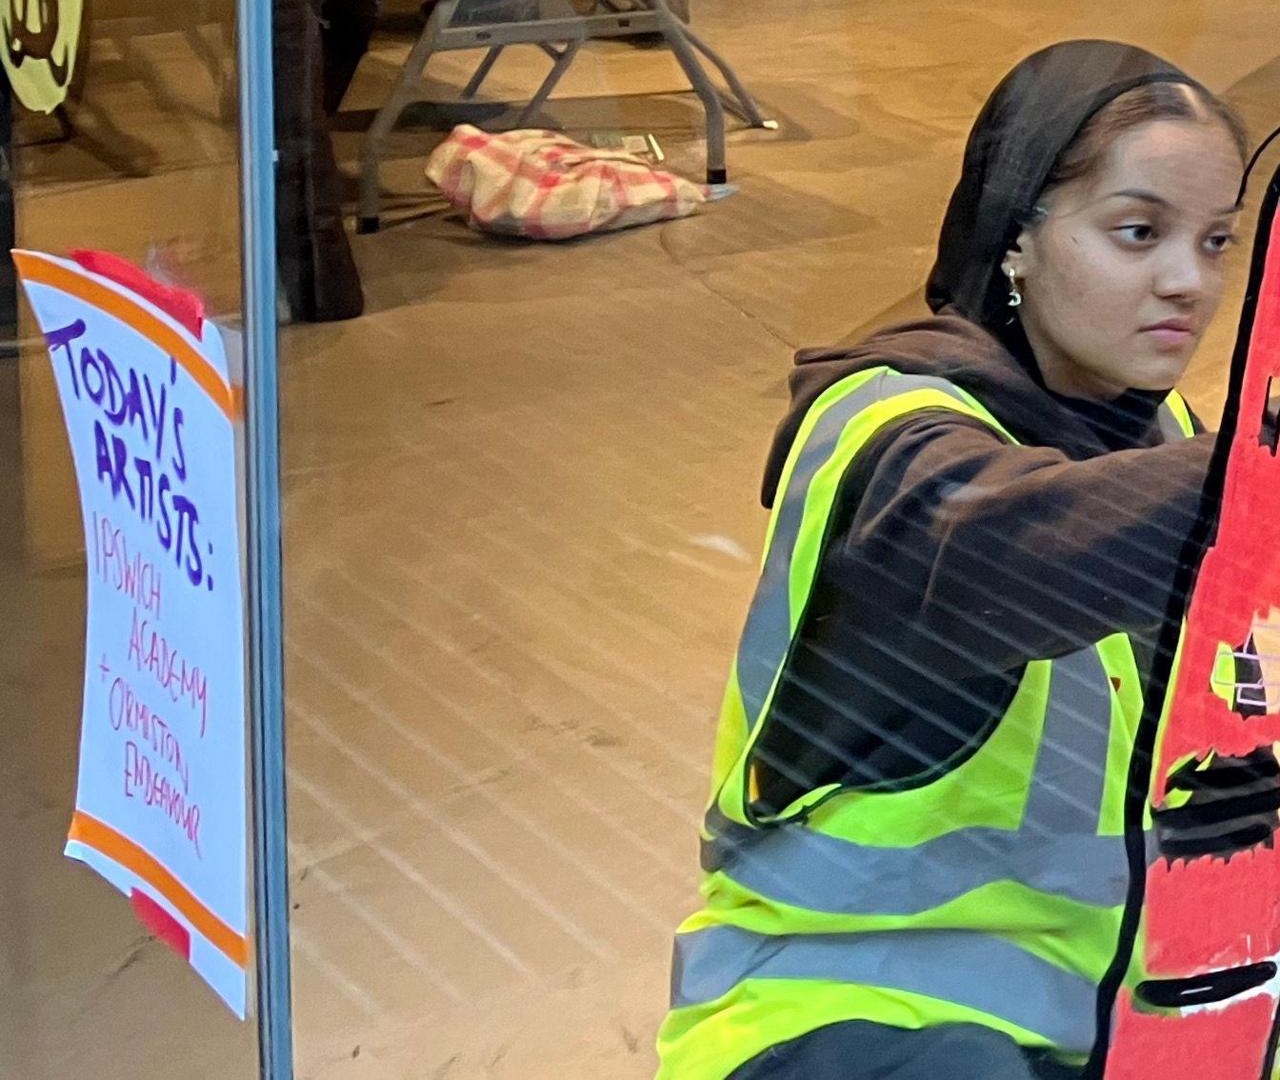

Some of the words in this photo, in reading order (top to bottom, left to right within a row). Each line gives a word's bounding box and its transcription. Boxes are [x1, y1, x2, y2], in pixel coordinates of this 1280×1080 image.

[44, 318, 187, 483] TODAY'S
[92, 510, 162, 621] IPSWICH
[94, 419, 214, 592] ARTISTS:
[109, 676, 189, 795] ORMISTON
[128, 606, 208, 739] ACADEMY
[125, 740, 203, 860] ENDEAVOUR
